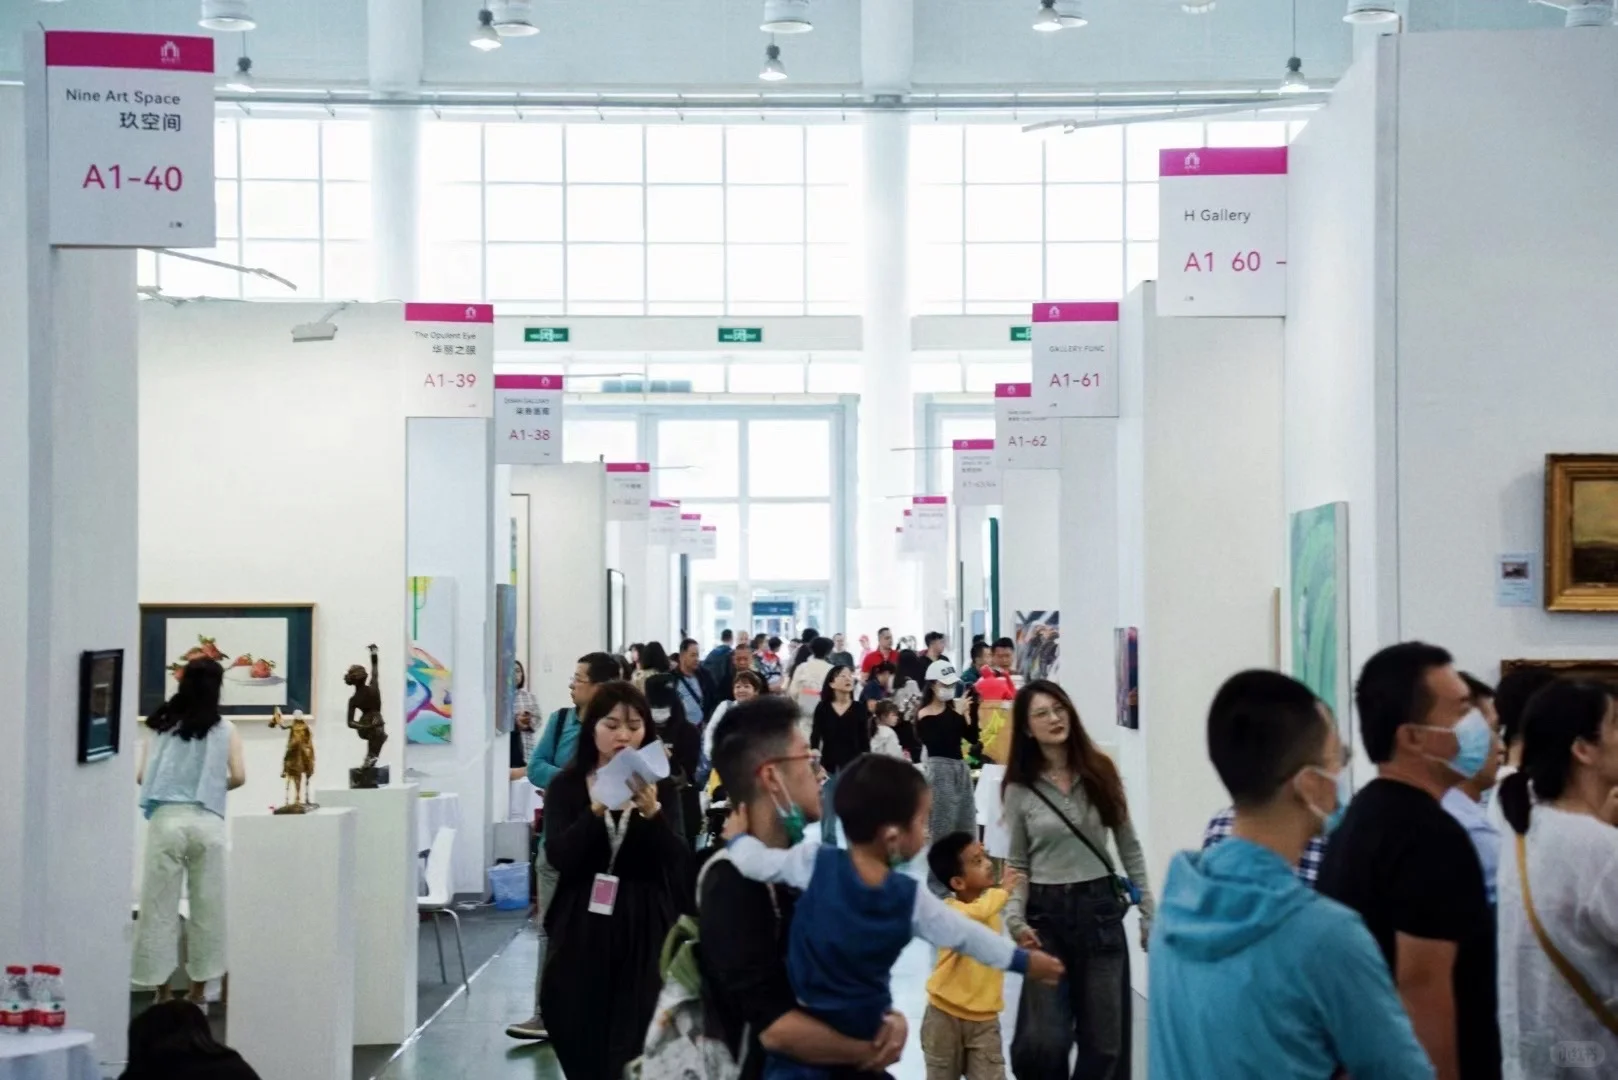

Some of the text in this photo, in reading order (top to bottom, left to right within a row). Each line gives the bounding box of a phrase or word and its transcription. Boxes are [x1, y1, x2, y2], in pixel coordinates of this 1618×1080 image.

[65, 88, 181, 106] Nine Art Space
[119, 111, 182, 132] 玖空间
[82, 163, 183, 192] A1-40
[1184, 208, 1252, 224] H Gallery
[1183, 251, 1214, 273] A1
[1231, 250, 1262, 273] 60
[430, 331, 461, 341] Opulent
[462, 331, 477, 341] Eye
[423, 373, 477, 388] A1-39
[1049, 372, 1101, 388] A1-61
[509, 428, 551, 442] A1-38
[1007, 434, 1048, 448] A1-62
